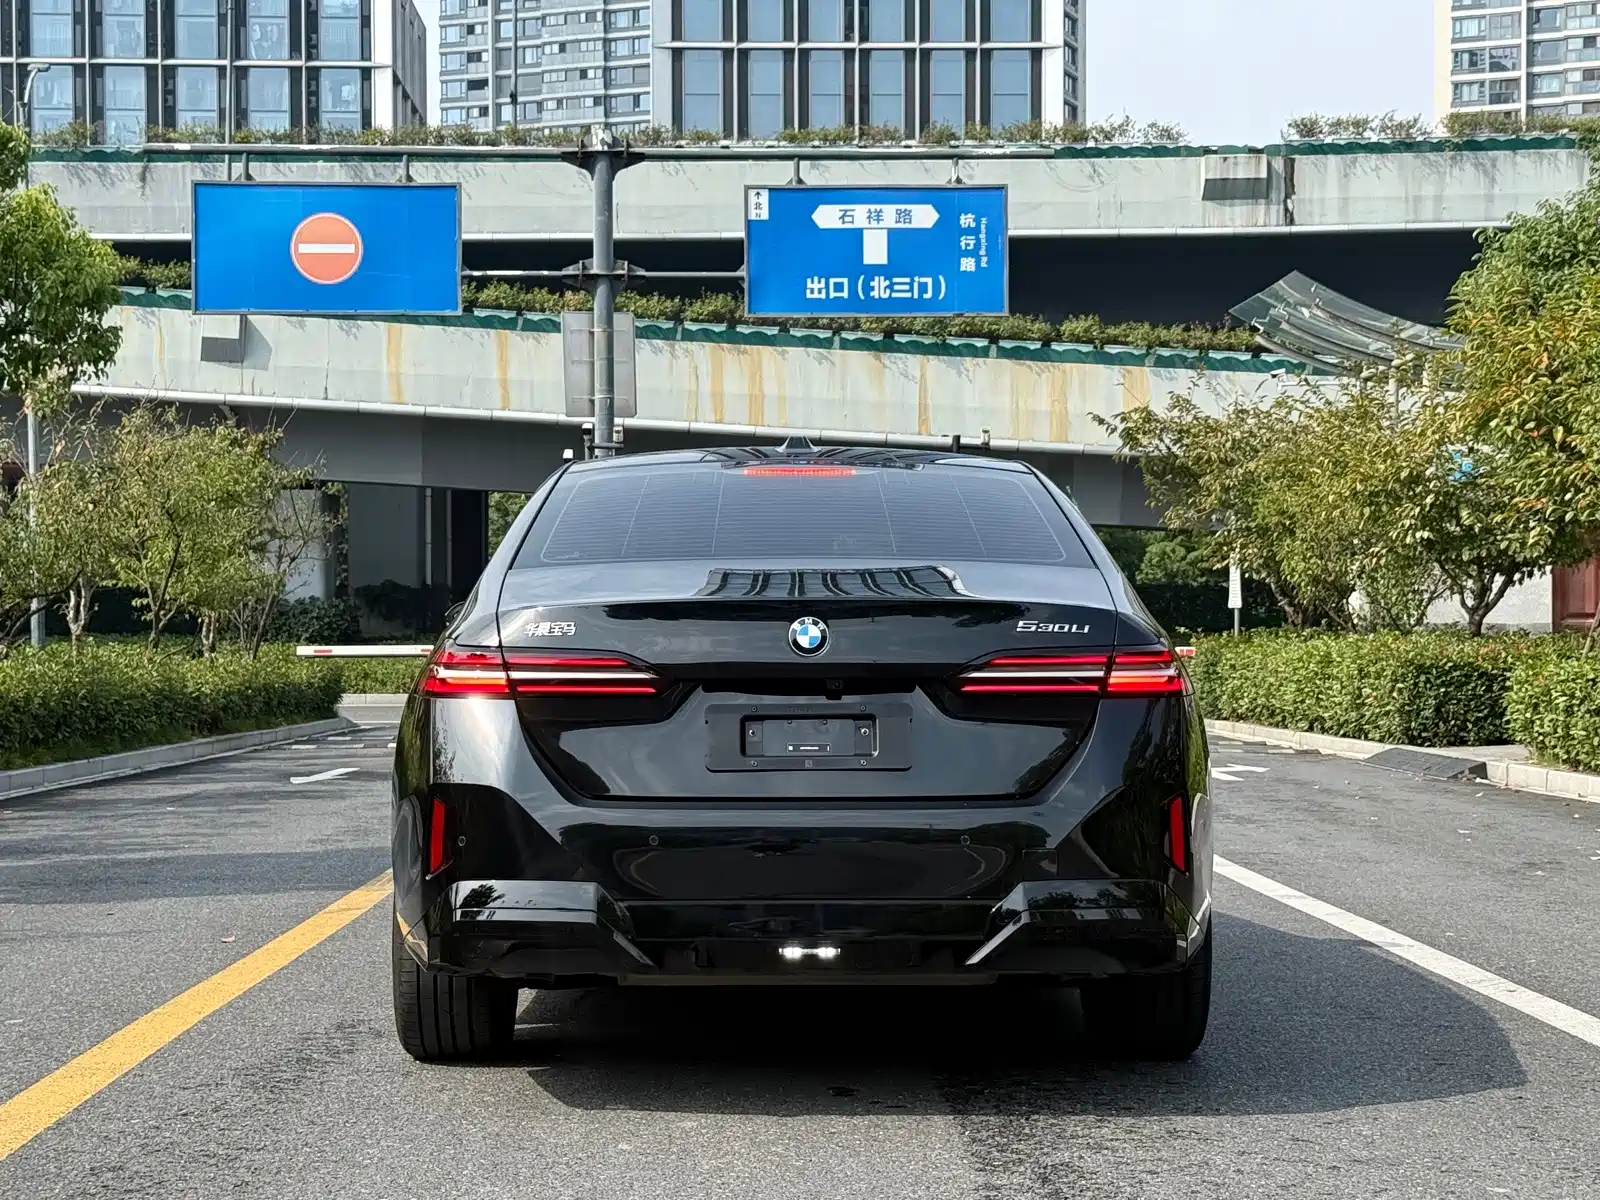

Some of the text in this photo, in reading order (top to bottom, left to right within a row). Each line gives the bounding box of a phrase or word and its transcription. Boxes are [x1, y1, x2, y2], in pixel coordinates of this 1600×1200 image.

[753, 201, 763, 211] 北
[838, 208, 913, 225] 石祥路
[959, 213, 976, 272] 杭行路
[979, 217, 988, 268] Hangxing Rd
[523, 621, 576, 637] 华晨宝马
